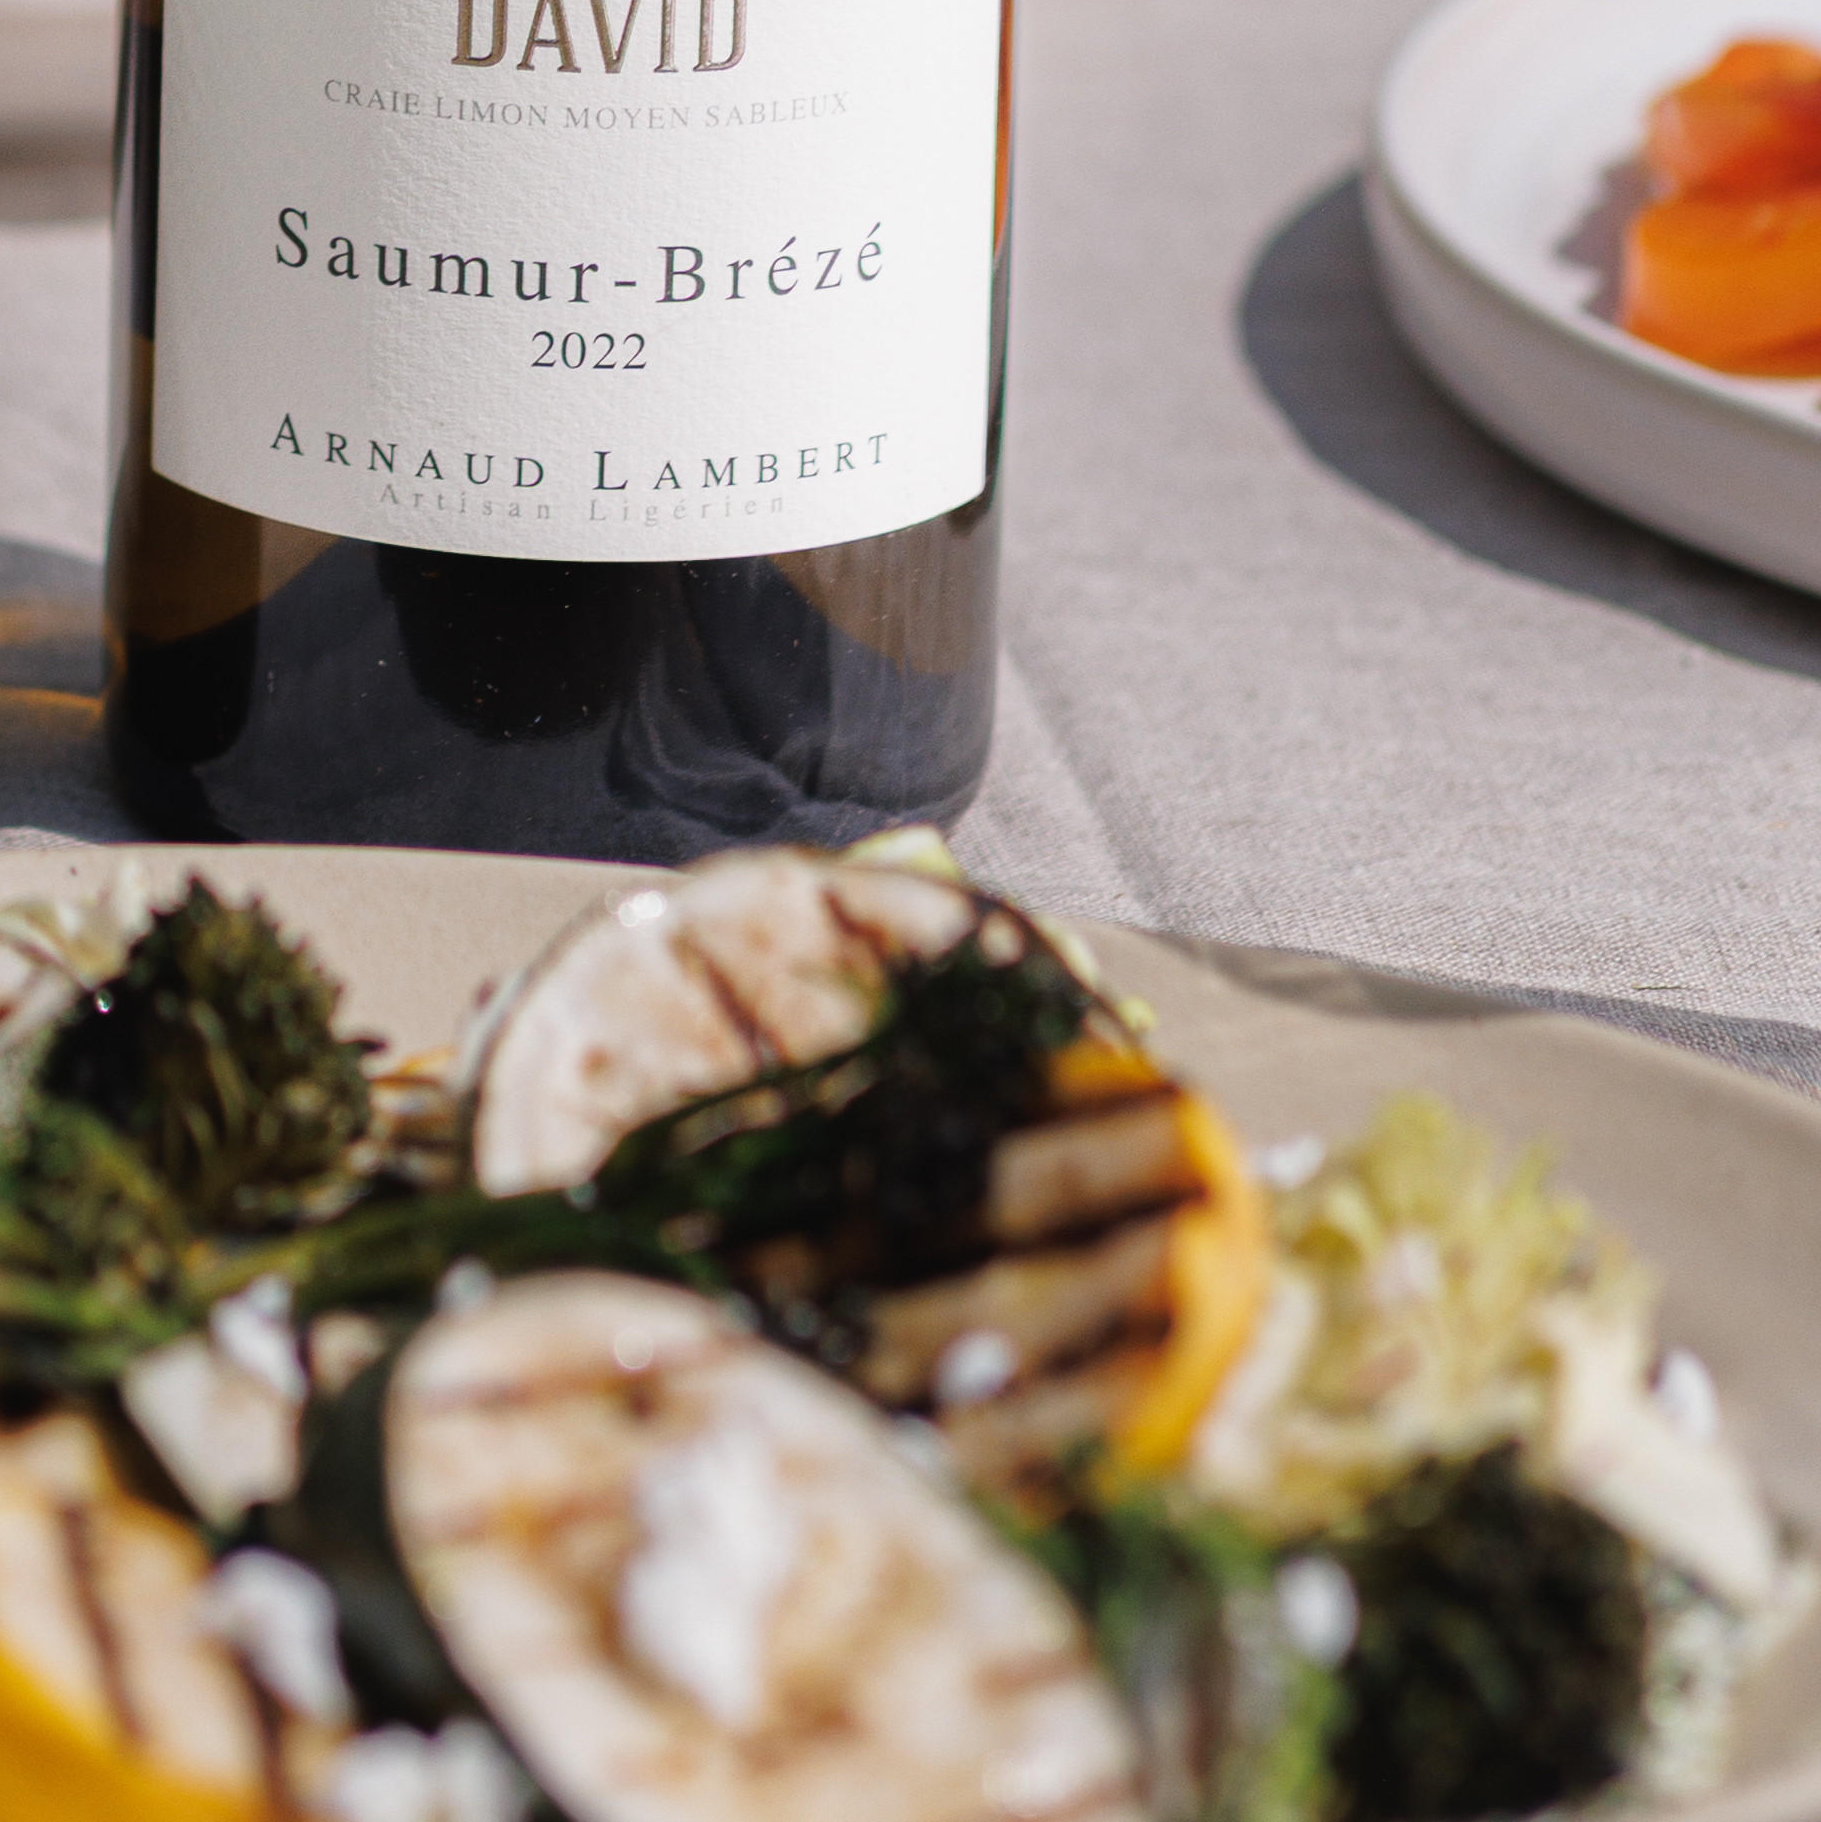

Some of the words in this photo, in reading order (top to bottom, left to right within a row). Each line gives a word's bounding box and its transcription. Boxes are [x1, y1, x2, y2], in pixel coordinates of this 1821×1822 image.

[323, 78, 422, 117] CRAIE
[435, 95, 549, 128] LIMON
[561, 105, 692, 131] MOYEN
[703, 90, 852, 130] SABLEUX
[273, 205, 887, 305] Saumur-Brézé
[528, 329, 650, 372] 2022
[269, 411, 546, 489] ARNAUD
[592, 431, 891, 491] LAMBERT
[378, 482, 552, 520] Artisan
[587, 495, 785, 527] Ligérien
